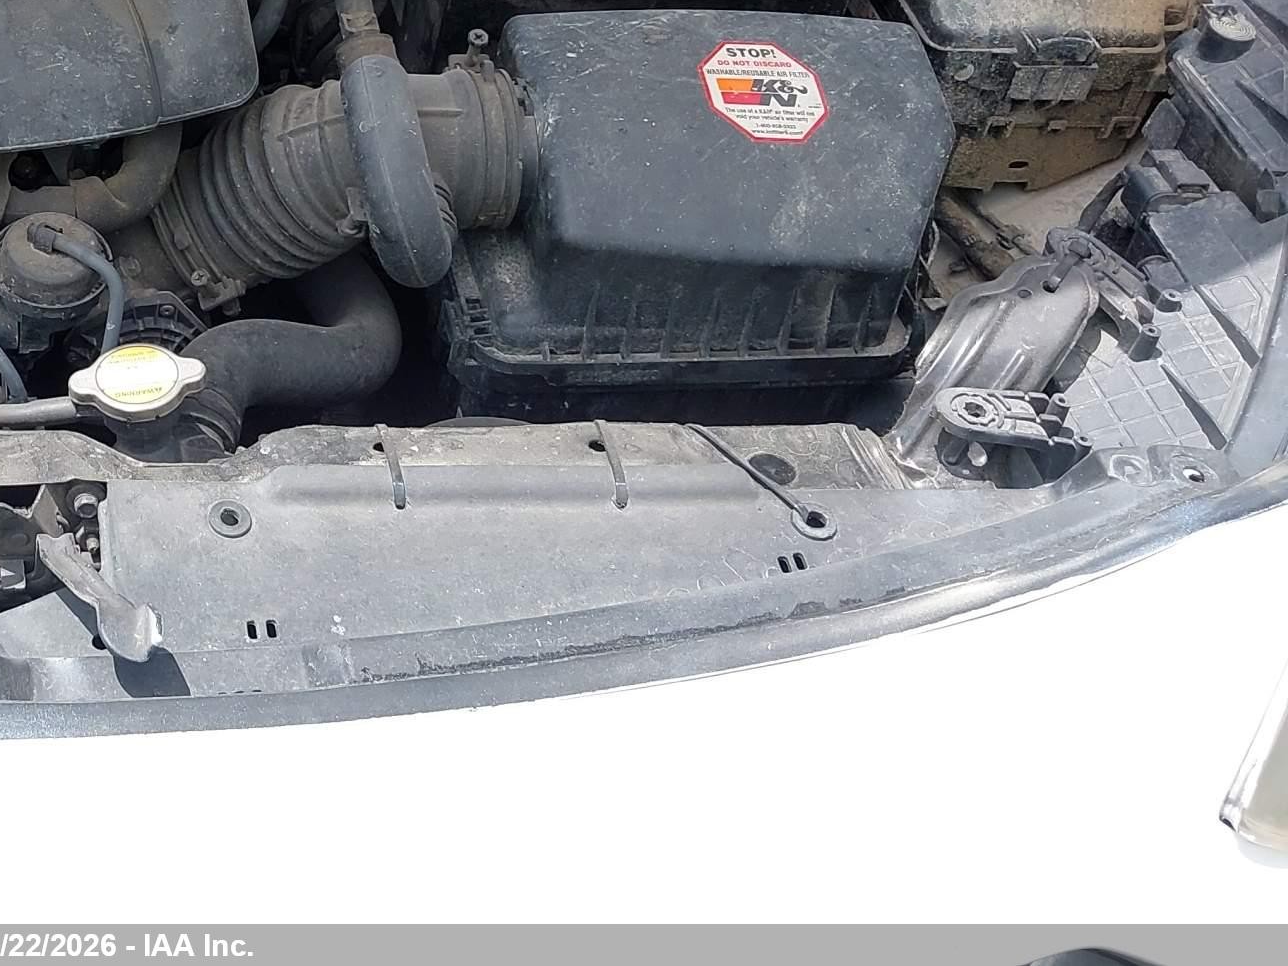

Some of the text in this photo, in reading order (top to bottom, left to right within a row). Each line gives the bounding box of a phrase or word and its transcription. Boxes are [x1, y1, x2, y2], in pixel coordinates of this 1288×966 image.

[725, 47, 777, 59] STOP!
[706, 68, 776, 77] WASHABLE/REUSABLE
[114, 387, 155, 398] WARNING
